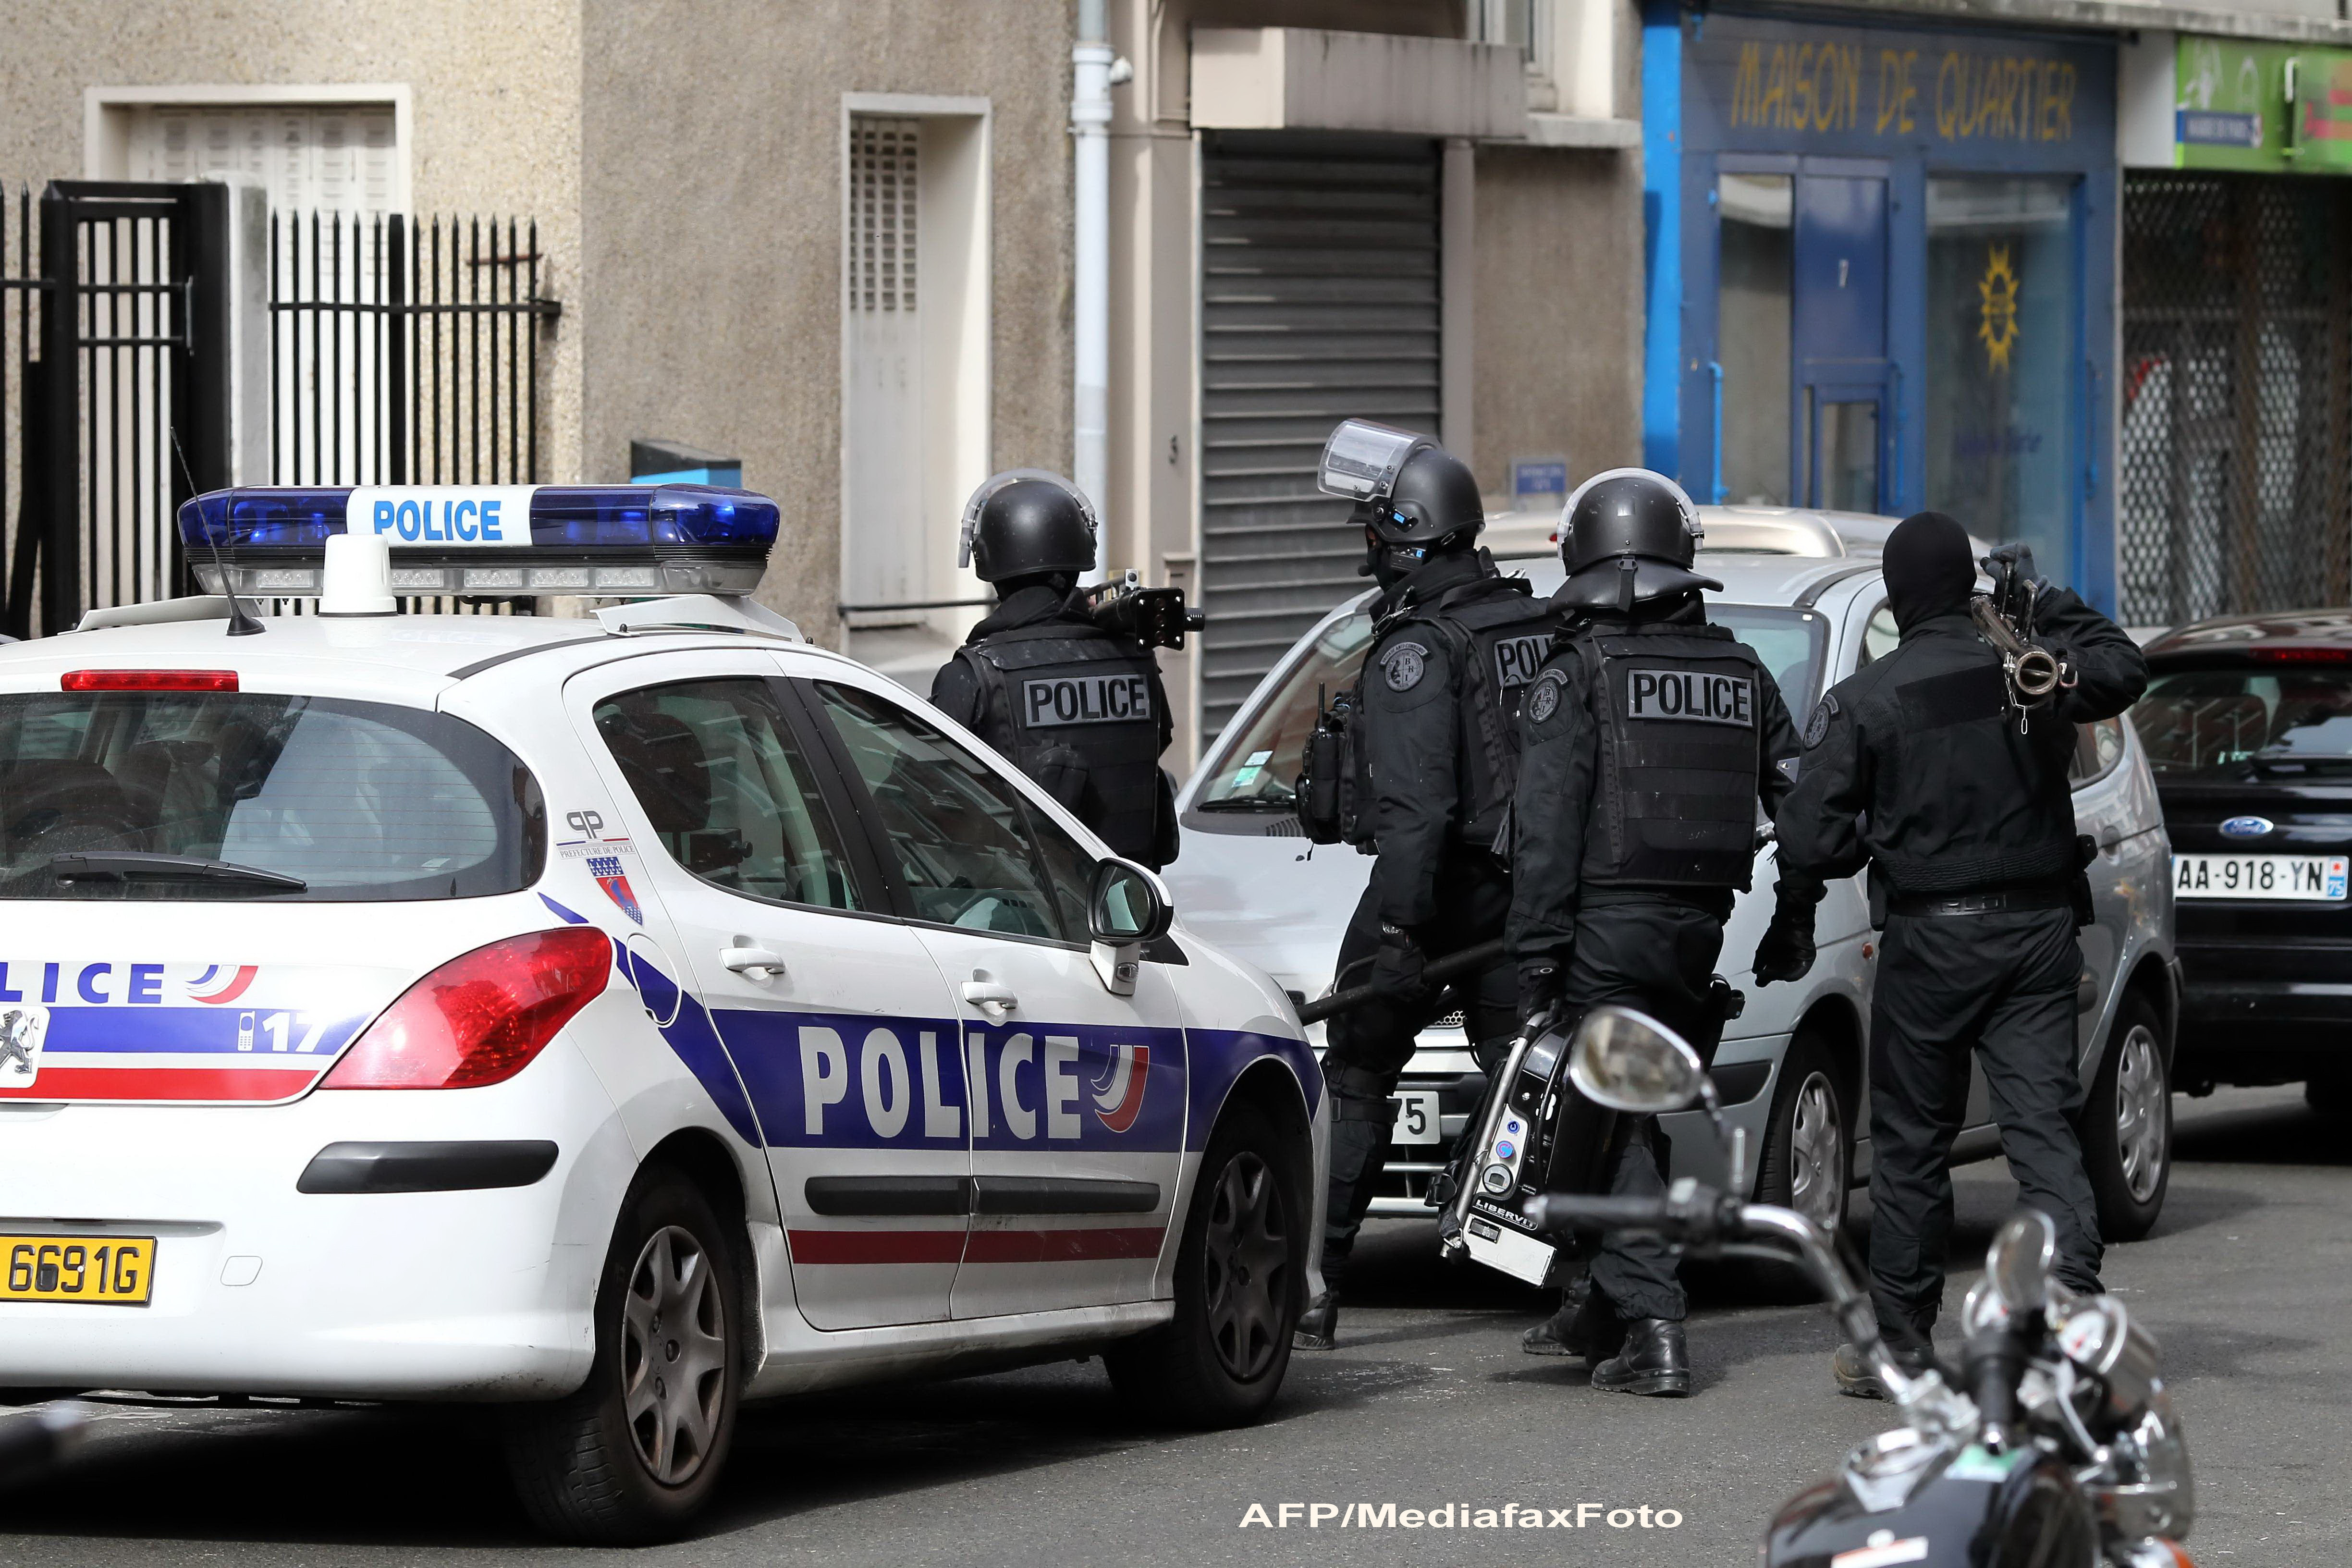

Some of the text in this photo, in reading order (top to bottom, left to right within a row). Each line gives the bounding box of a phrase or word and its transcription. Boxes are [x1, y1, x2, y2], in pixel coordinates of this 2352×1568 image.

[1731, 42, 2077, 142] MAISON DE QUARTIER
[373, 500, 503, 541] POLICE
[1029, 678, 1146, 723] POLICE
[1634, 674, 1749, 722] POLICE
[560, 847, 603, 858] PREFECTURE
[612, 845, 635, 854] POLICE
[2178, 860, 2322, 891] AA-918-YN
[262, 1012, 332, 1052] 17
[798, 1026, 1081, 1140] POLICE
[9, 1245, 139, 1294] 6691G
